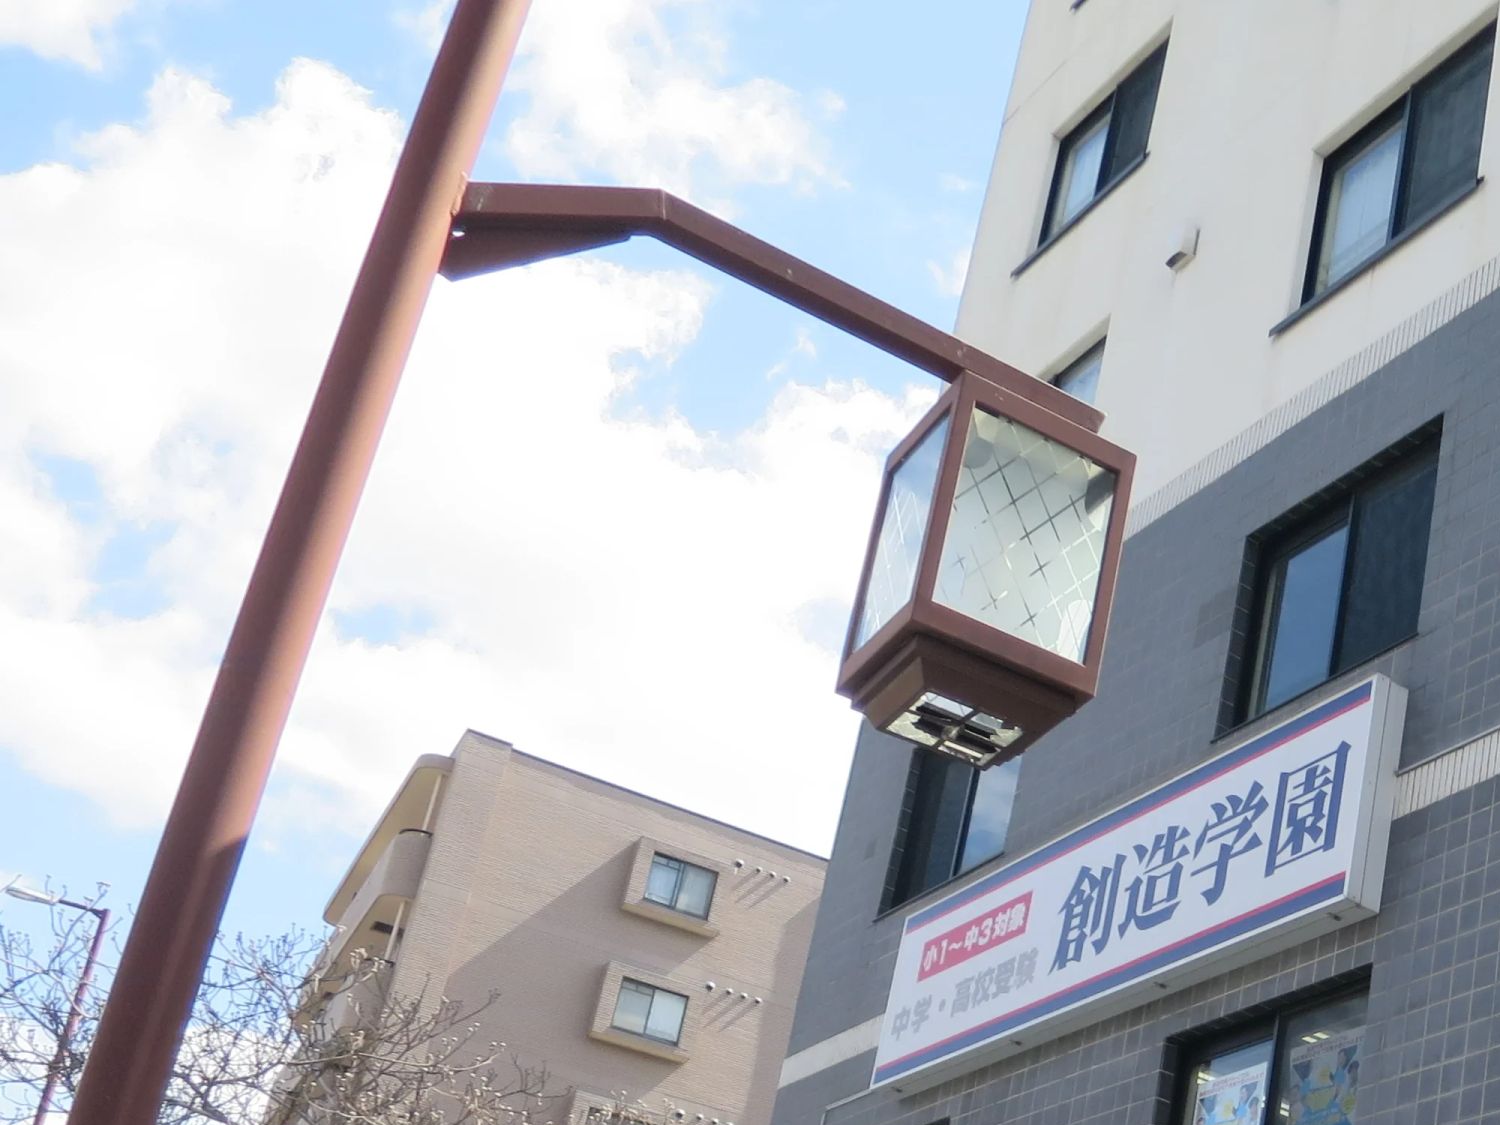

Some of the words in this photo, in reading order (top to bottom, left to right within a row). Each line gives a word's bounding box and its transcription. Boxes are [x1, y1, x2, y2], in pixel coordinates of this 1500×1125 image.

[1048, 741, 1352, 975] 創造学園
[891, 947, 1039, 1041] 中学・高校受験
